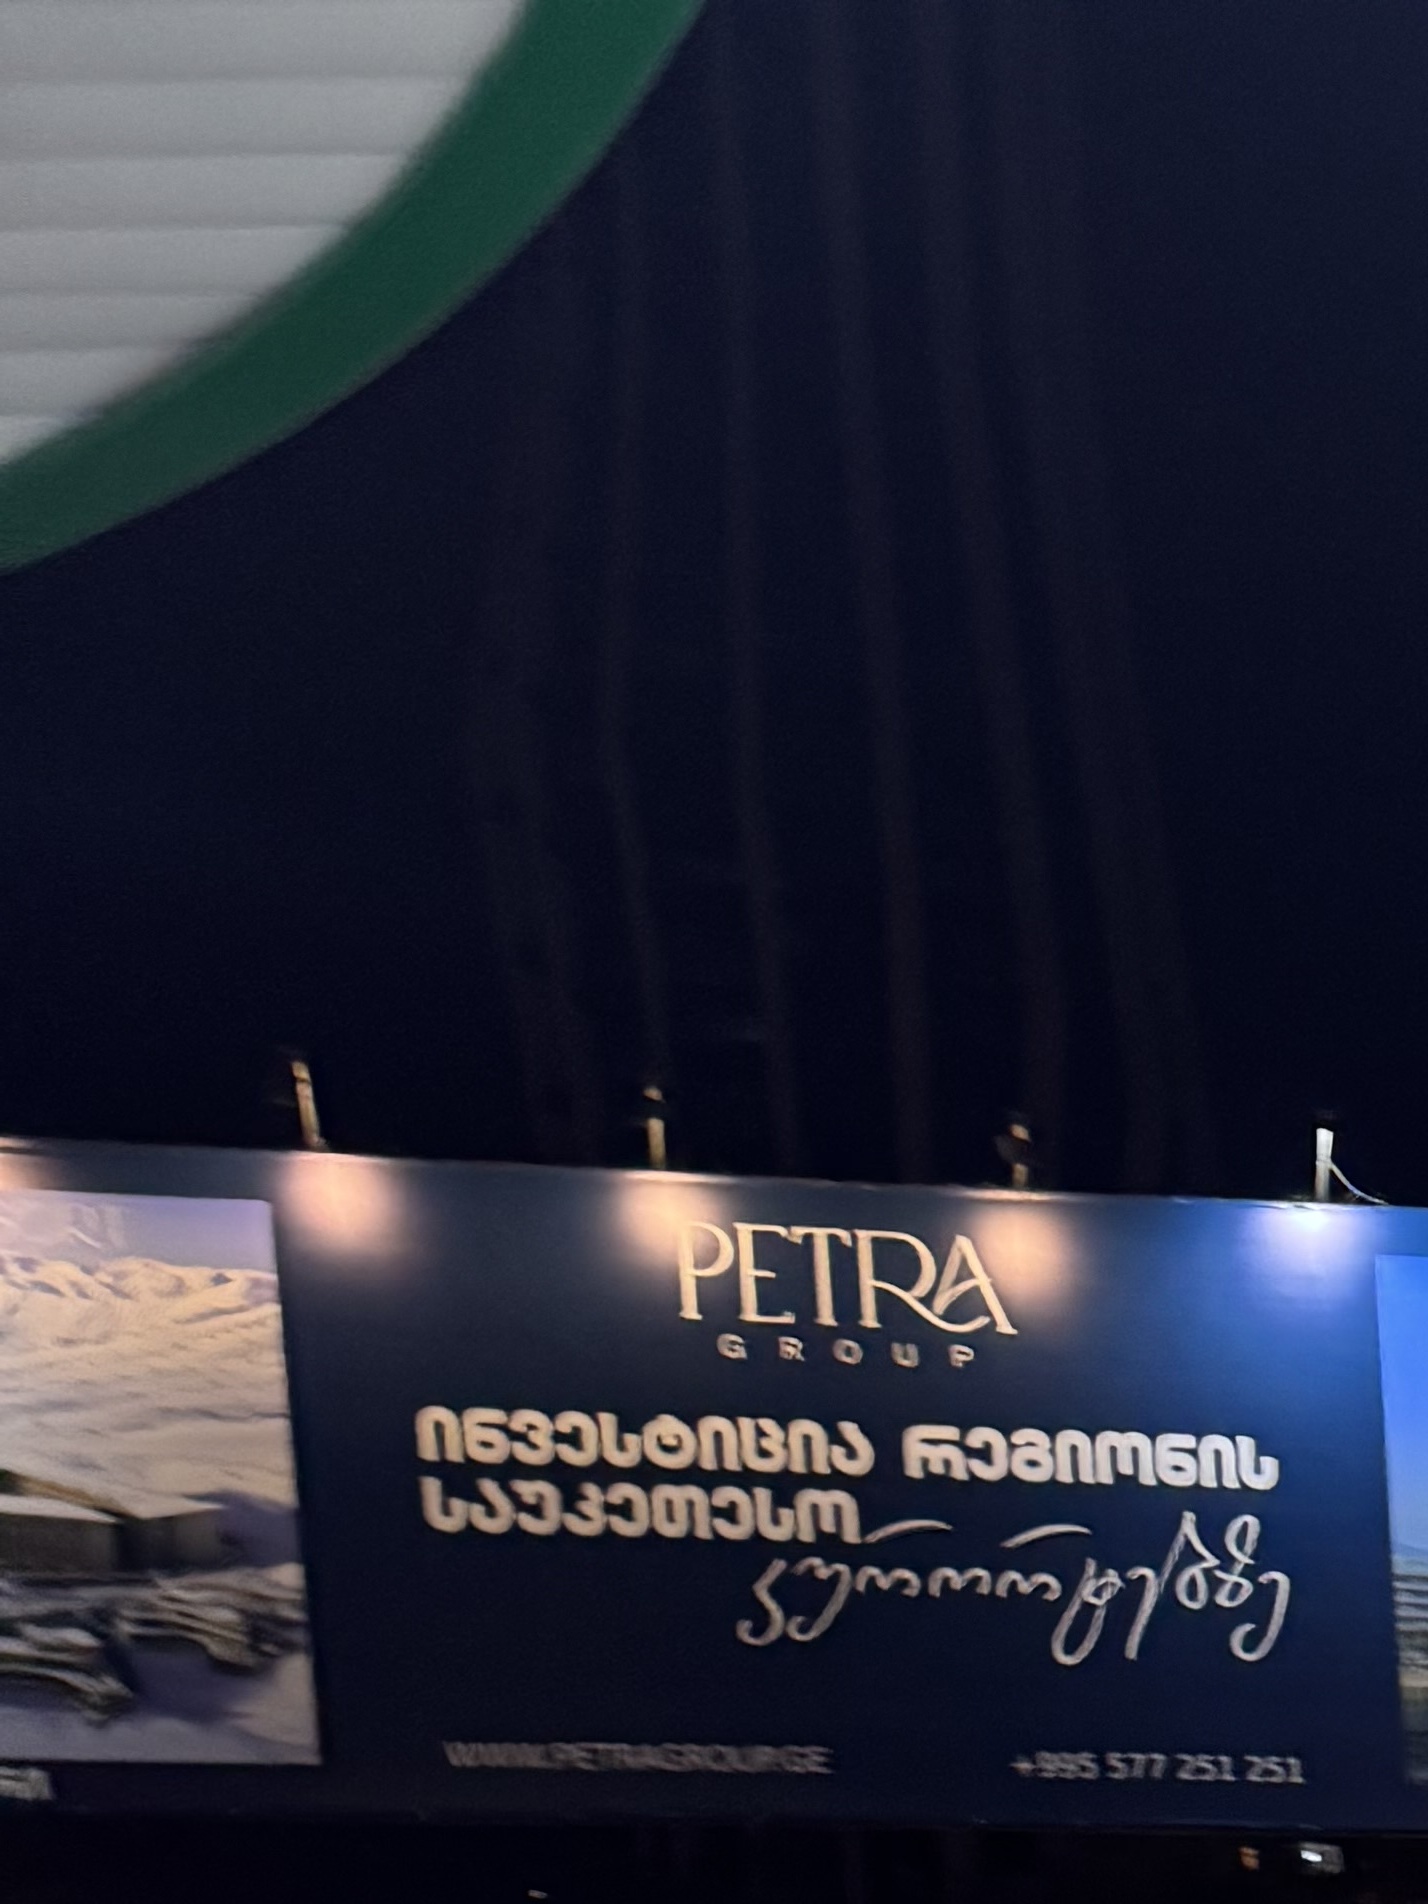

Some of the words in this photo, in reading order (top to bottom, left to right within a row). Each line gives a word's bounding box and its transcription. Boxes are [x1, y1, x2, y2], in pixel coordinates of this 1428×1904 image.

[678, 1221, 1018, 1335] PETRA
[716, 1333, 975, 1368] GROUP
[414, 1405, 875, 1476] ინვესტიცია
[901, 1424, 1280, 1491] რეგიონის
[418, 1476, 866, 1544] საუკეთესო
[1105, 1752, 1168, 1781] 577
[1174, 1753, 1239, 1783] 251
[1244, 1754, 1307, 1785] 251
